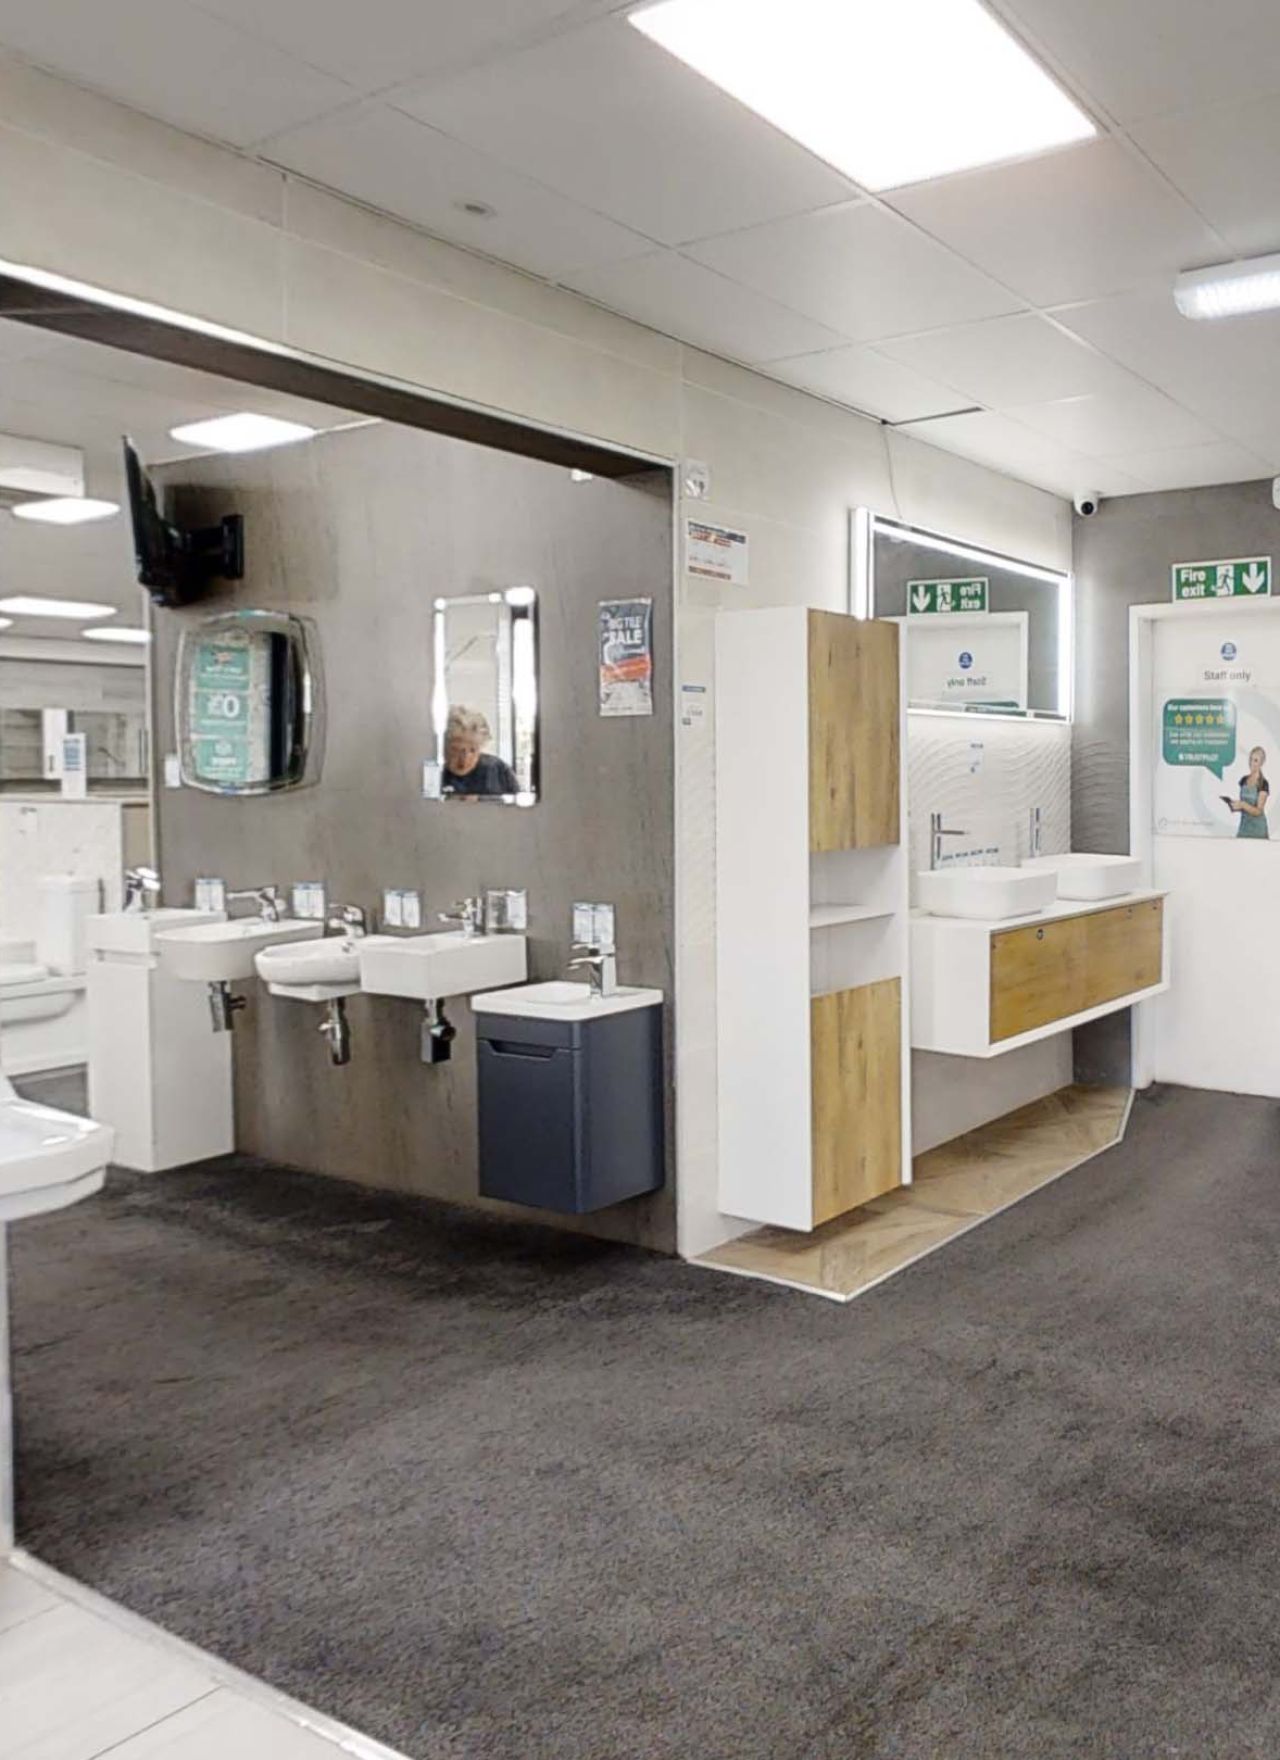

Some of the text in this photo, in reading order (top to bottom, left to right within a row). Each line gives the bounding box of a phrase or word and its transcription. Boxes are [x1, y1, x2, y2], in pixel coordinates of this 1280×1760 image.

[1180, 568, 1206, 582] Fire
[1181, 584, 1205, 597] exit
[625, 616, 641, 629] TILE
[609, 629, 642, 645] SALE
[1204, 669, 1251, 682] Staff only
